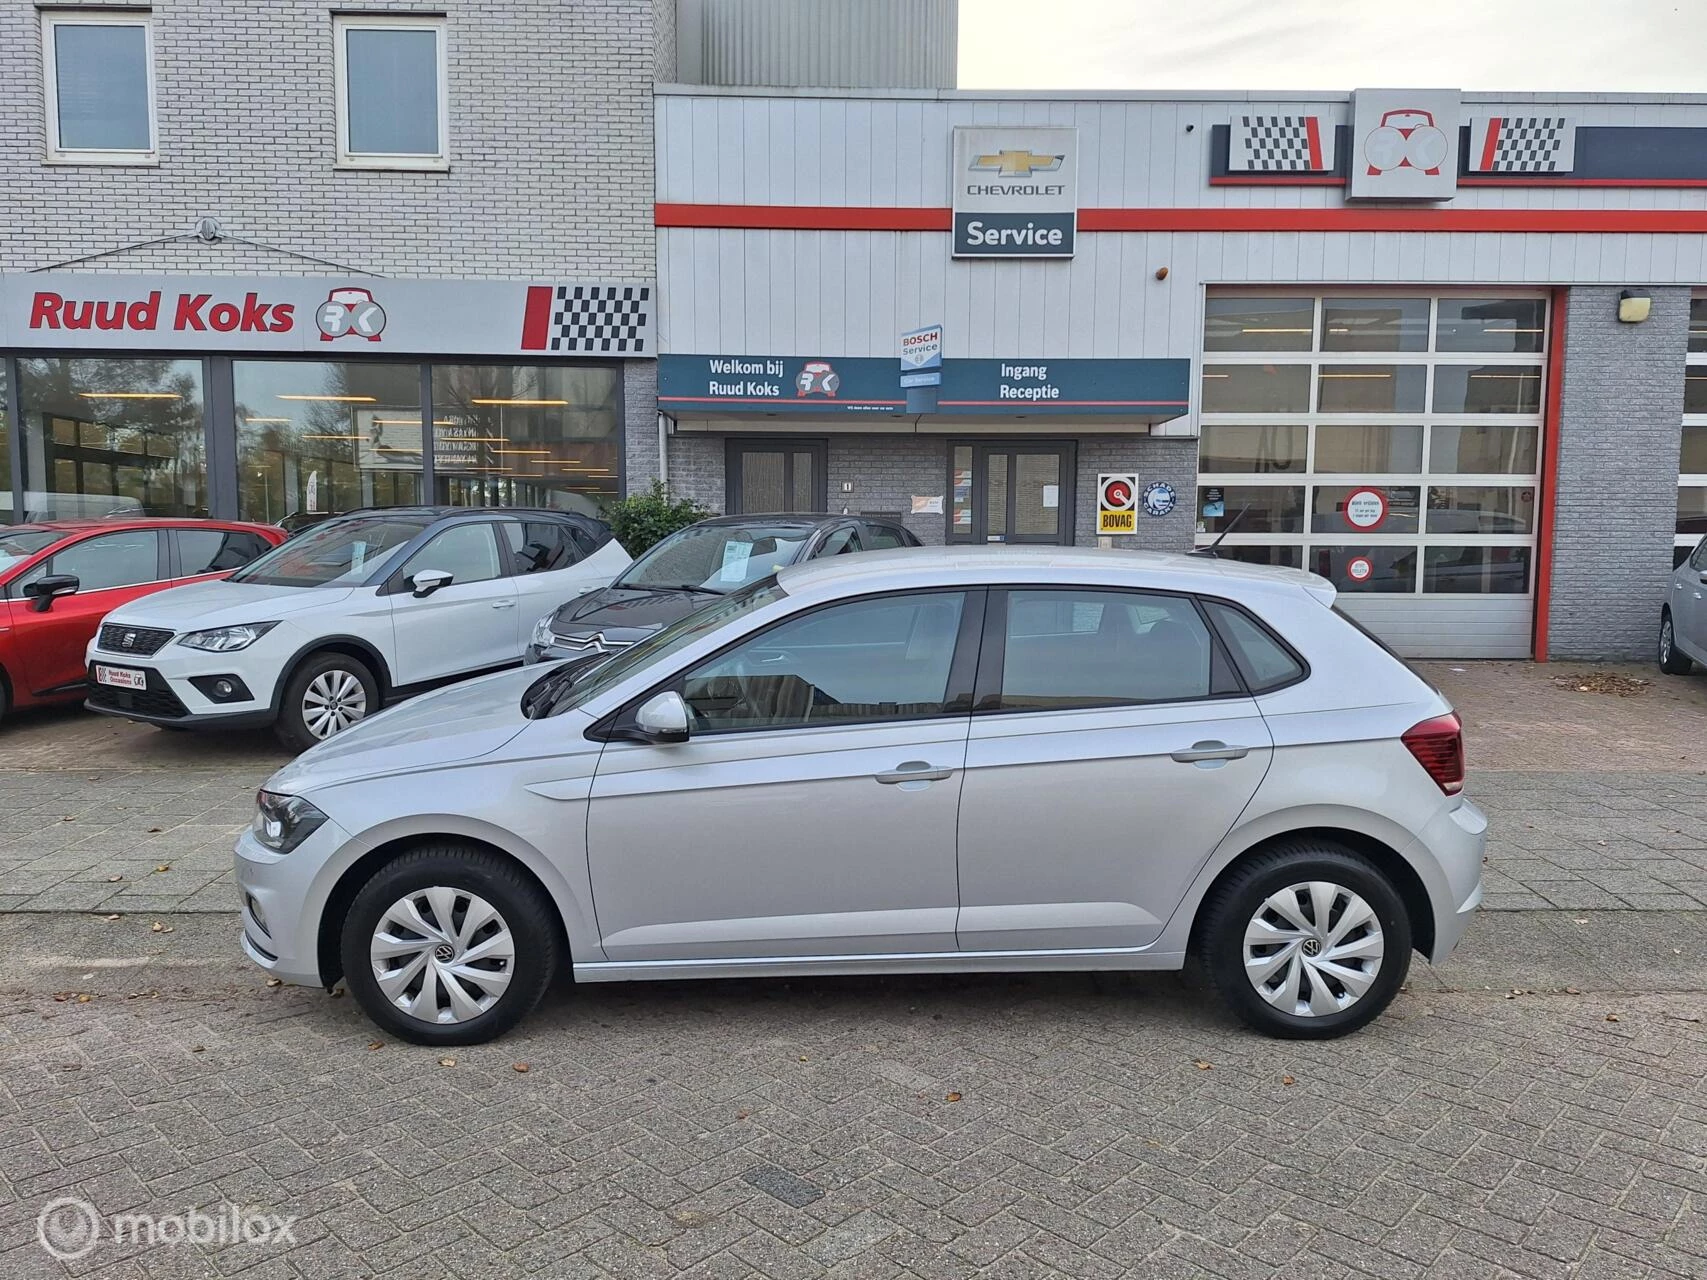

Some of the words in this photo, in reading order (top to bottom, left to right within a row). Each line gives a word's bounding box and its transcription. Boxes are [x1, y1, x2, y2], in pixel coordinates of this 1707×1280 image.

[967, 184, 1065, 196] CHEVROLET
[967, 221, 1063, 246] Service
[29, 291, 161, 331] Ruud
[174, 292, 294, 333] Koks
[903, 332, 938, 347] BOSCH
[903, 344, 938, 356] Service
[709, 359, 764, 375] Welkom
[766, 361, 784, 378] bij
[1001, 363, 1048, 380] Ingang
[709, 381, 747, 396] Ruud
[747, 382, 780, 397] Koks
[1000, 384, 1060, 401] Receptie
[1143, 482, 1175, 499] SCHADE
[1143, 501, 1174, 516] GARANT
[1103, 514, 1132, 528] BOVAG
